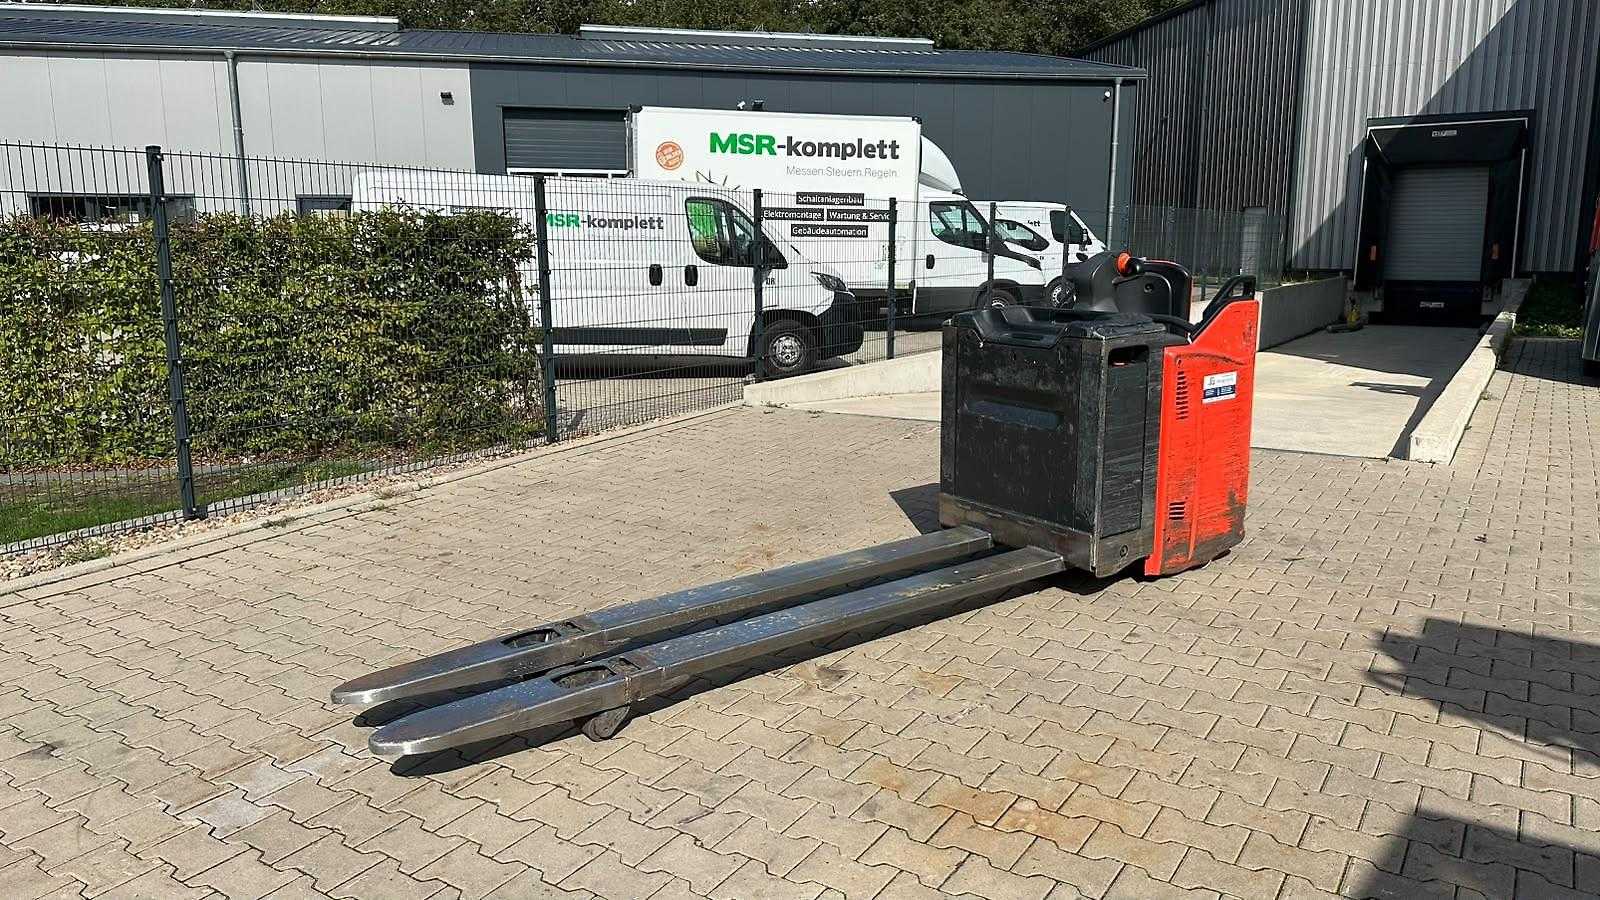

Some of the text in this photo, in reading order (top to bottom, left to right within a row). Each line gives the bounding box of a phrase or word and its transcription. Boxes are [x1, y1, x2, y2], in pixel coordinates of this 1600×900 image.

[710, 132, 900, 160] MSR-komplett
[798, 195, 863, 205] Schaltanlagenbau
[763, 210, 822, 220] Elektromontage
[829, 211, 860, 221] Wartung
[862, 212, 867, 220] &
[792, 226, 867, 236] Gebäudeautomation
